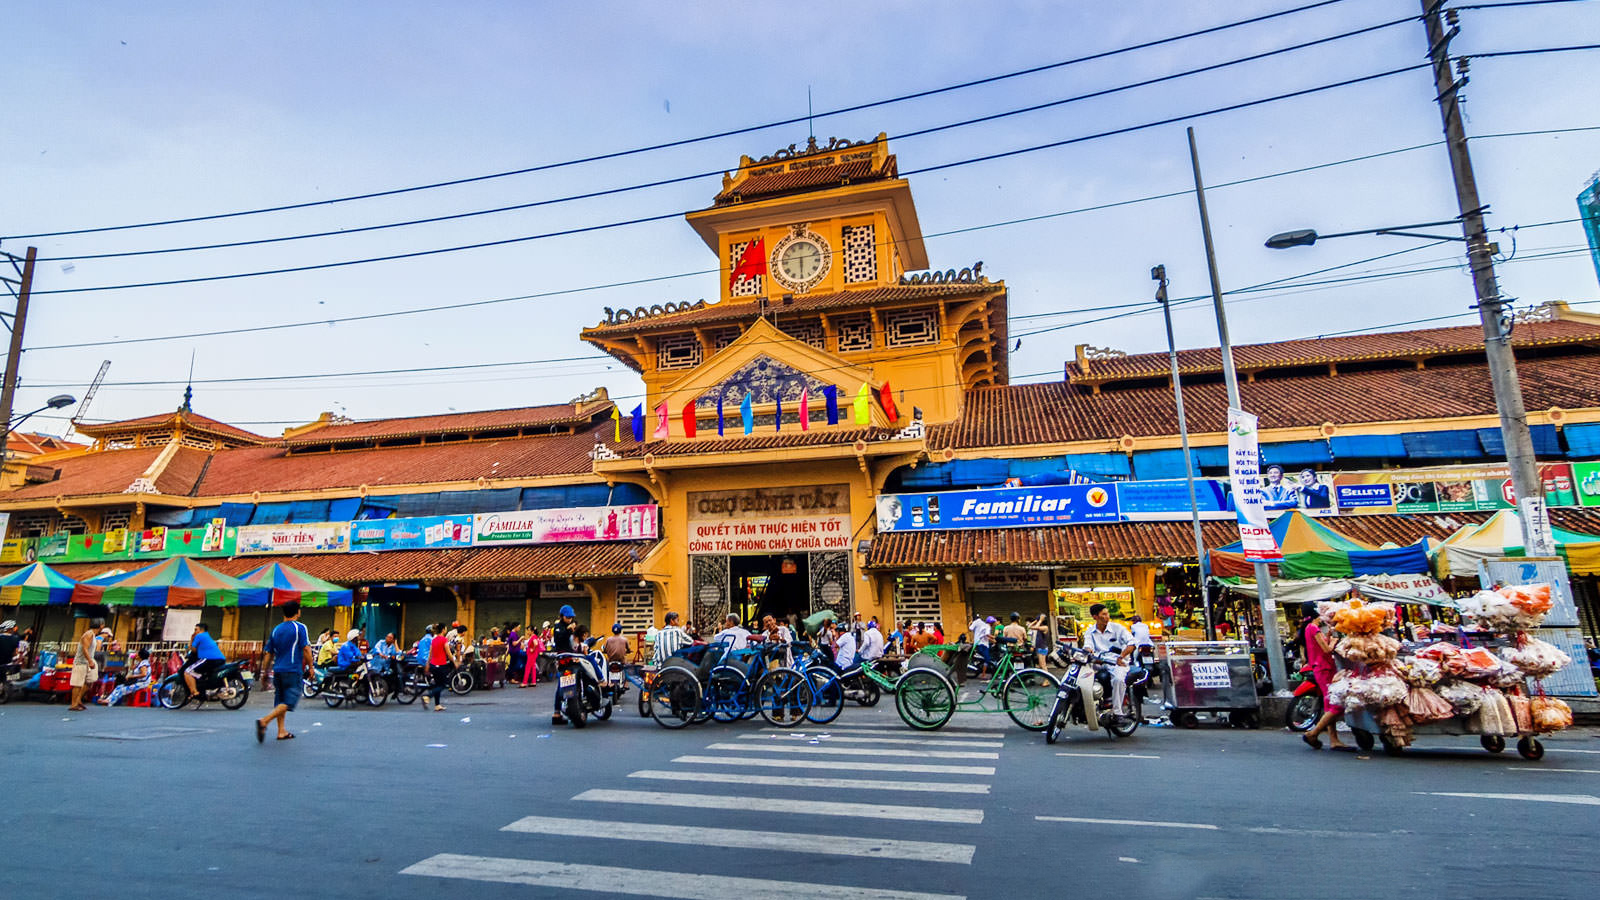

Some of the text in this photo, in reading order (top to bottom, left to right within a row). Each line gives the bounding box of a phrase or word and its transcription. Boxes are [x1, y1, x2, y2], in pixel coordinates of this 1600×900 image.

[1341, 488, 1386, 497] SELLEYS
[698, 498, 737, 516] CHỢ
[742, 489, 795, 512] BÌNH
[961, 496, 1072, 515] Familiar
[489, 521, 533, 531] FAMILIAR
[697, 517, 841, 537] QUYẾT TÂM THỰC HIỆN TỐT
[689, 534, 849, 551] CÔNG TÁC PHÒNG CHÁY CHỮA CHÁY
